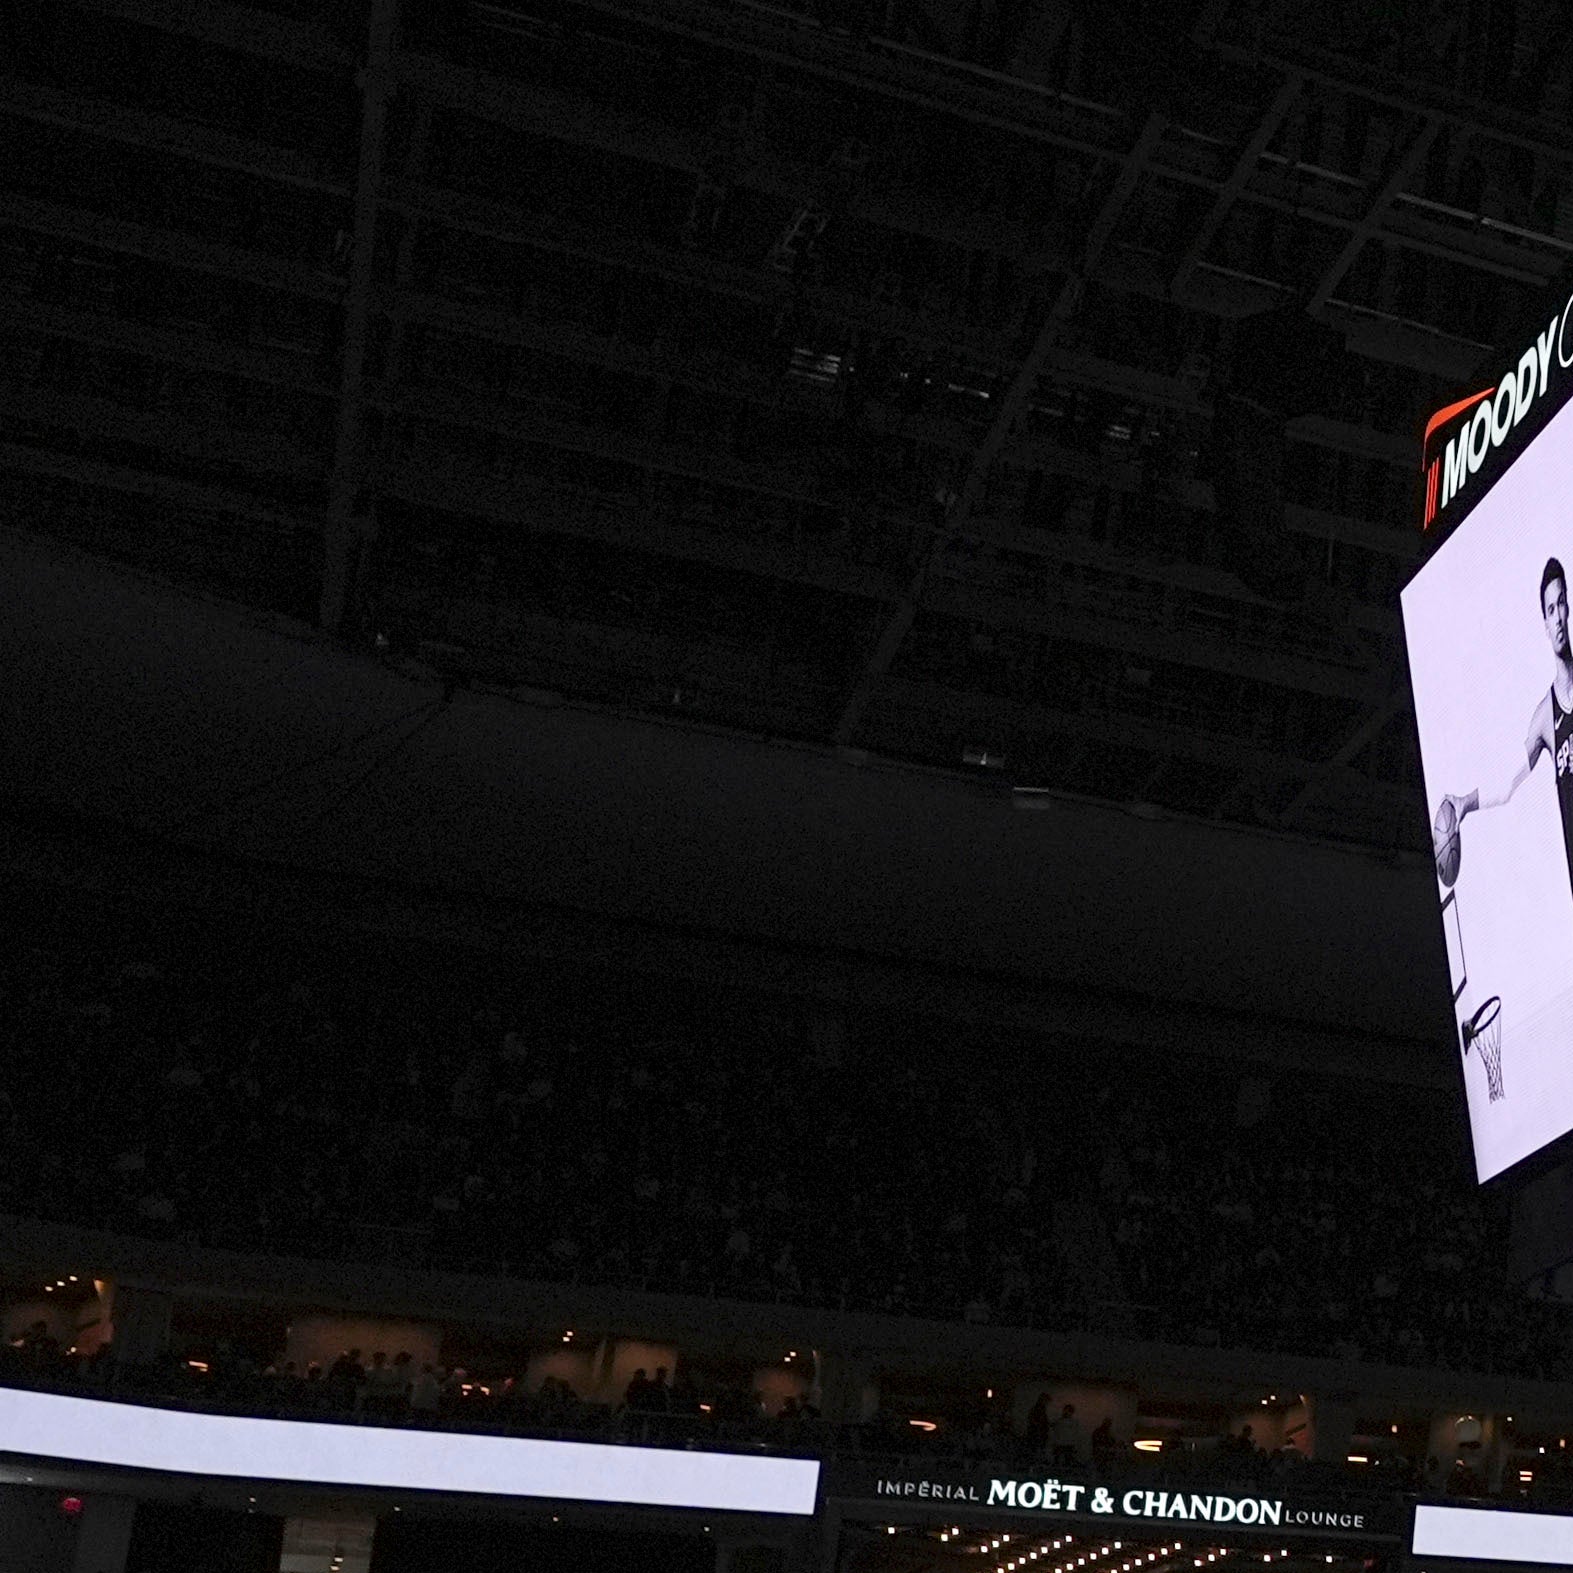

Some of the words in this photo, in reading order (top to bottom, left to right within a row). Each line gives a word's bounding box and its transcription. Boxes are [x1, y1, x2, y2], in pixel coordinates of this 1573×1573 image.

[1441, 315, 1559, 509] MOODY
[986, 1478, 1085, 1511] MOËT
[1090, 1486, 1115, 1514] &
[1122, 1490, 1283, 1526] CHANDON
[1285, 1509, 1365, 1529] LOUNGE
